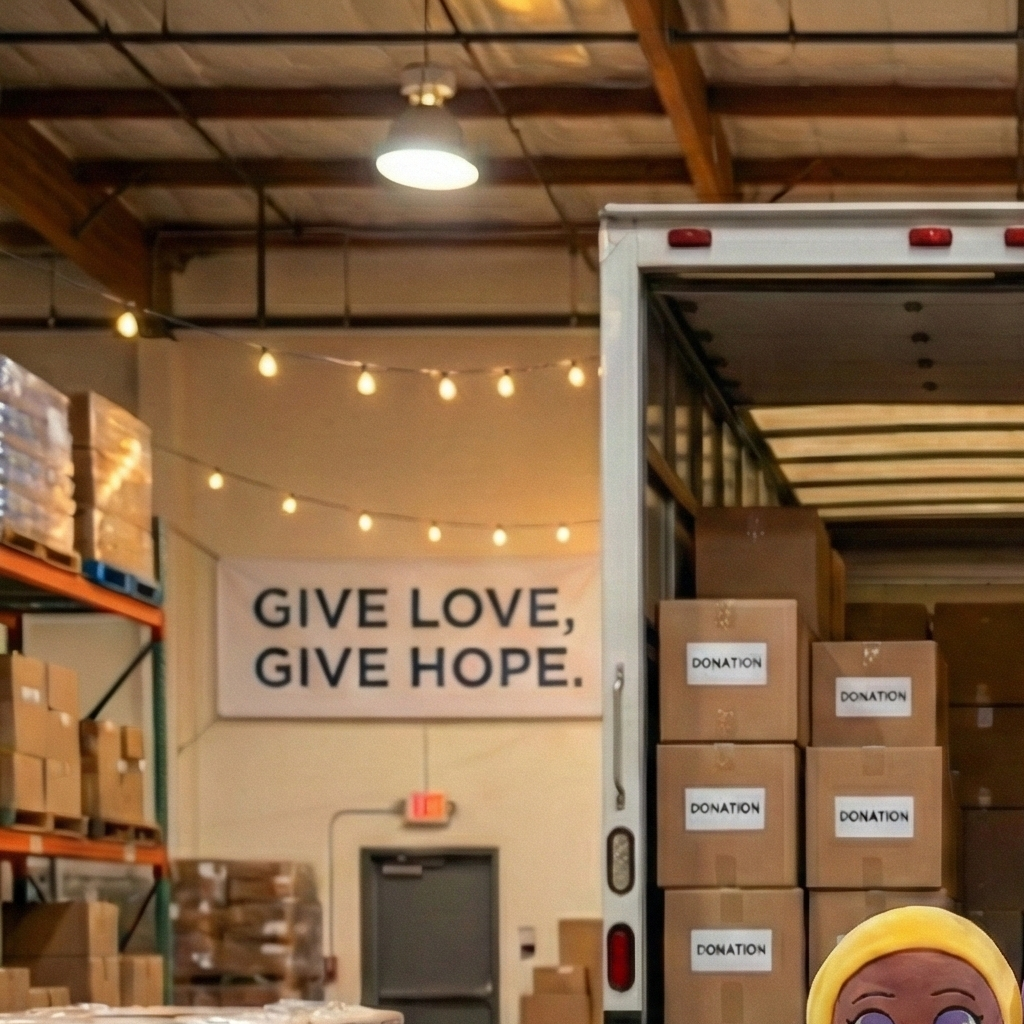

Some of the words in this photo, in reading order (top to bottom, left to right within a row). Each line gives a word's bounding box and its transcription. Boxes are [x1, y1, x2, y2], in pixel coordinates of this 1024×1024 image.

[252, 586, 388, 631] GIVE
[410, 586, 575, 636] LOVE,
[254, 646, 389, 690] GIVE
[410, 646, 583, 690] HOPE.
[692, 656, 762, 669] DONATION
[841, 690, 907, 703] DONATION
[691, 801, 760, 815] DONATION
[840, 810, 909, 823] DONATION
[697, 943, 766, 956] DONATION
